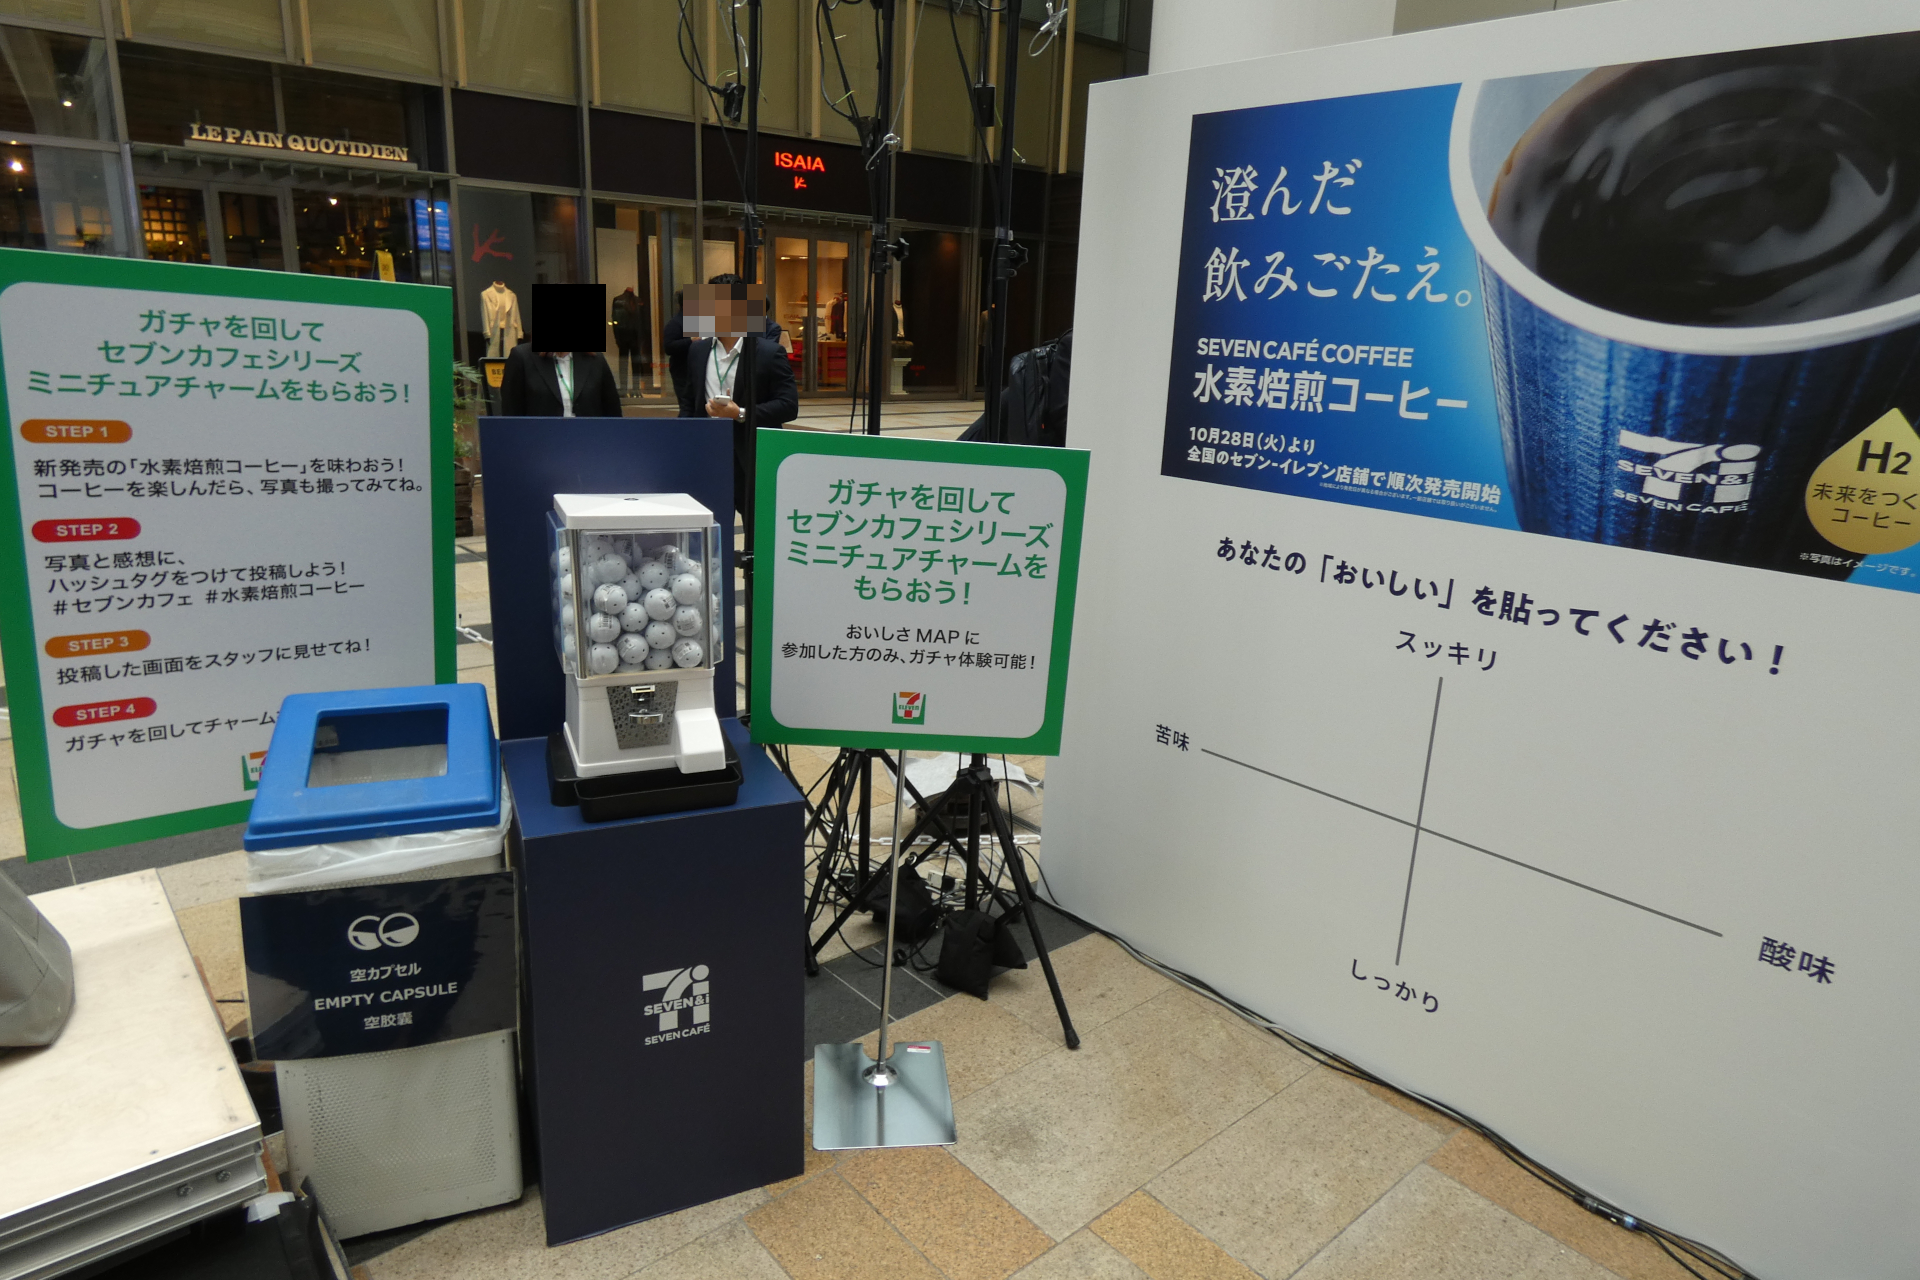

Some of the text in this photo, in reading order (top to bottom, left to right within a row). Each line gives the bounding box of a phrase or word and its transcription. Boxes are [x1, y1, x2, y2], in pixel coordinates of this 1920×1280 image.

[190, 123, 409, 162] LE PAIN QUOTIDIEN
[775, 151, 826, 172] ISAIA
[1210, 158, 1363, 223] 澄んだ
[1202, 246, 1472, 307] 飲みごたえ。
[139, 309, 325, 343] ガチャを回して
[98, 341, 363, 374] セブンカフェシリーズ
[1197, 337, 1414, 368] SEVEN CAFÉ COFFEE
[1192, 363, 1469, 421] 水素焙煎コーヒー
[45, 424, 109, 438] STEP 1
[1856, 439, 1912, 476] H2
[38, 476, 424, 499] コーヒーを楽しんだら、写真も撮ってみてね。
[828, 478, 1015, 515] ガチャを回して
[1613, 488, 1683, 512] SEVEN
[1811, 482, 1919, 510] 未来をつく
[56, 523, 119, 537] STEP 2
[786, 509, 1054, 548] セブンカフェシリーズ
[1831, 508, 1911, 529] コーヒー
[45, 550, 187, 572] 写真と感想に、
[786, 541, 1048, 579] ミニチュアチャームを
[68, 636, 129, 651] STEP 3
[846, 624, 980, 645] おいしさ MAP に
[1395, 629, 1499, 671] スッキリ
[76, 703, 136, 721] STEP 4
[65, 710, 280, 753] ガチャを回してチャーム
[1155, 723, 1190, 753] 苦味
[350, 962, 422, 983] 空カプセル
[1757, 935, 1836, 986] 酸味
[314, 982, 458, 1011] EMPTY CAPSULE
[1351, 957, 1441, 1015] しっかり
[644, 1022, 711, 1046] SEVEN CAFÉ
